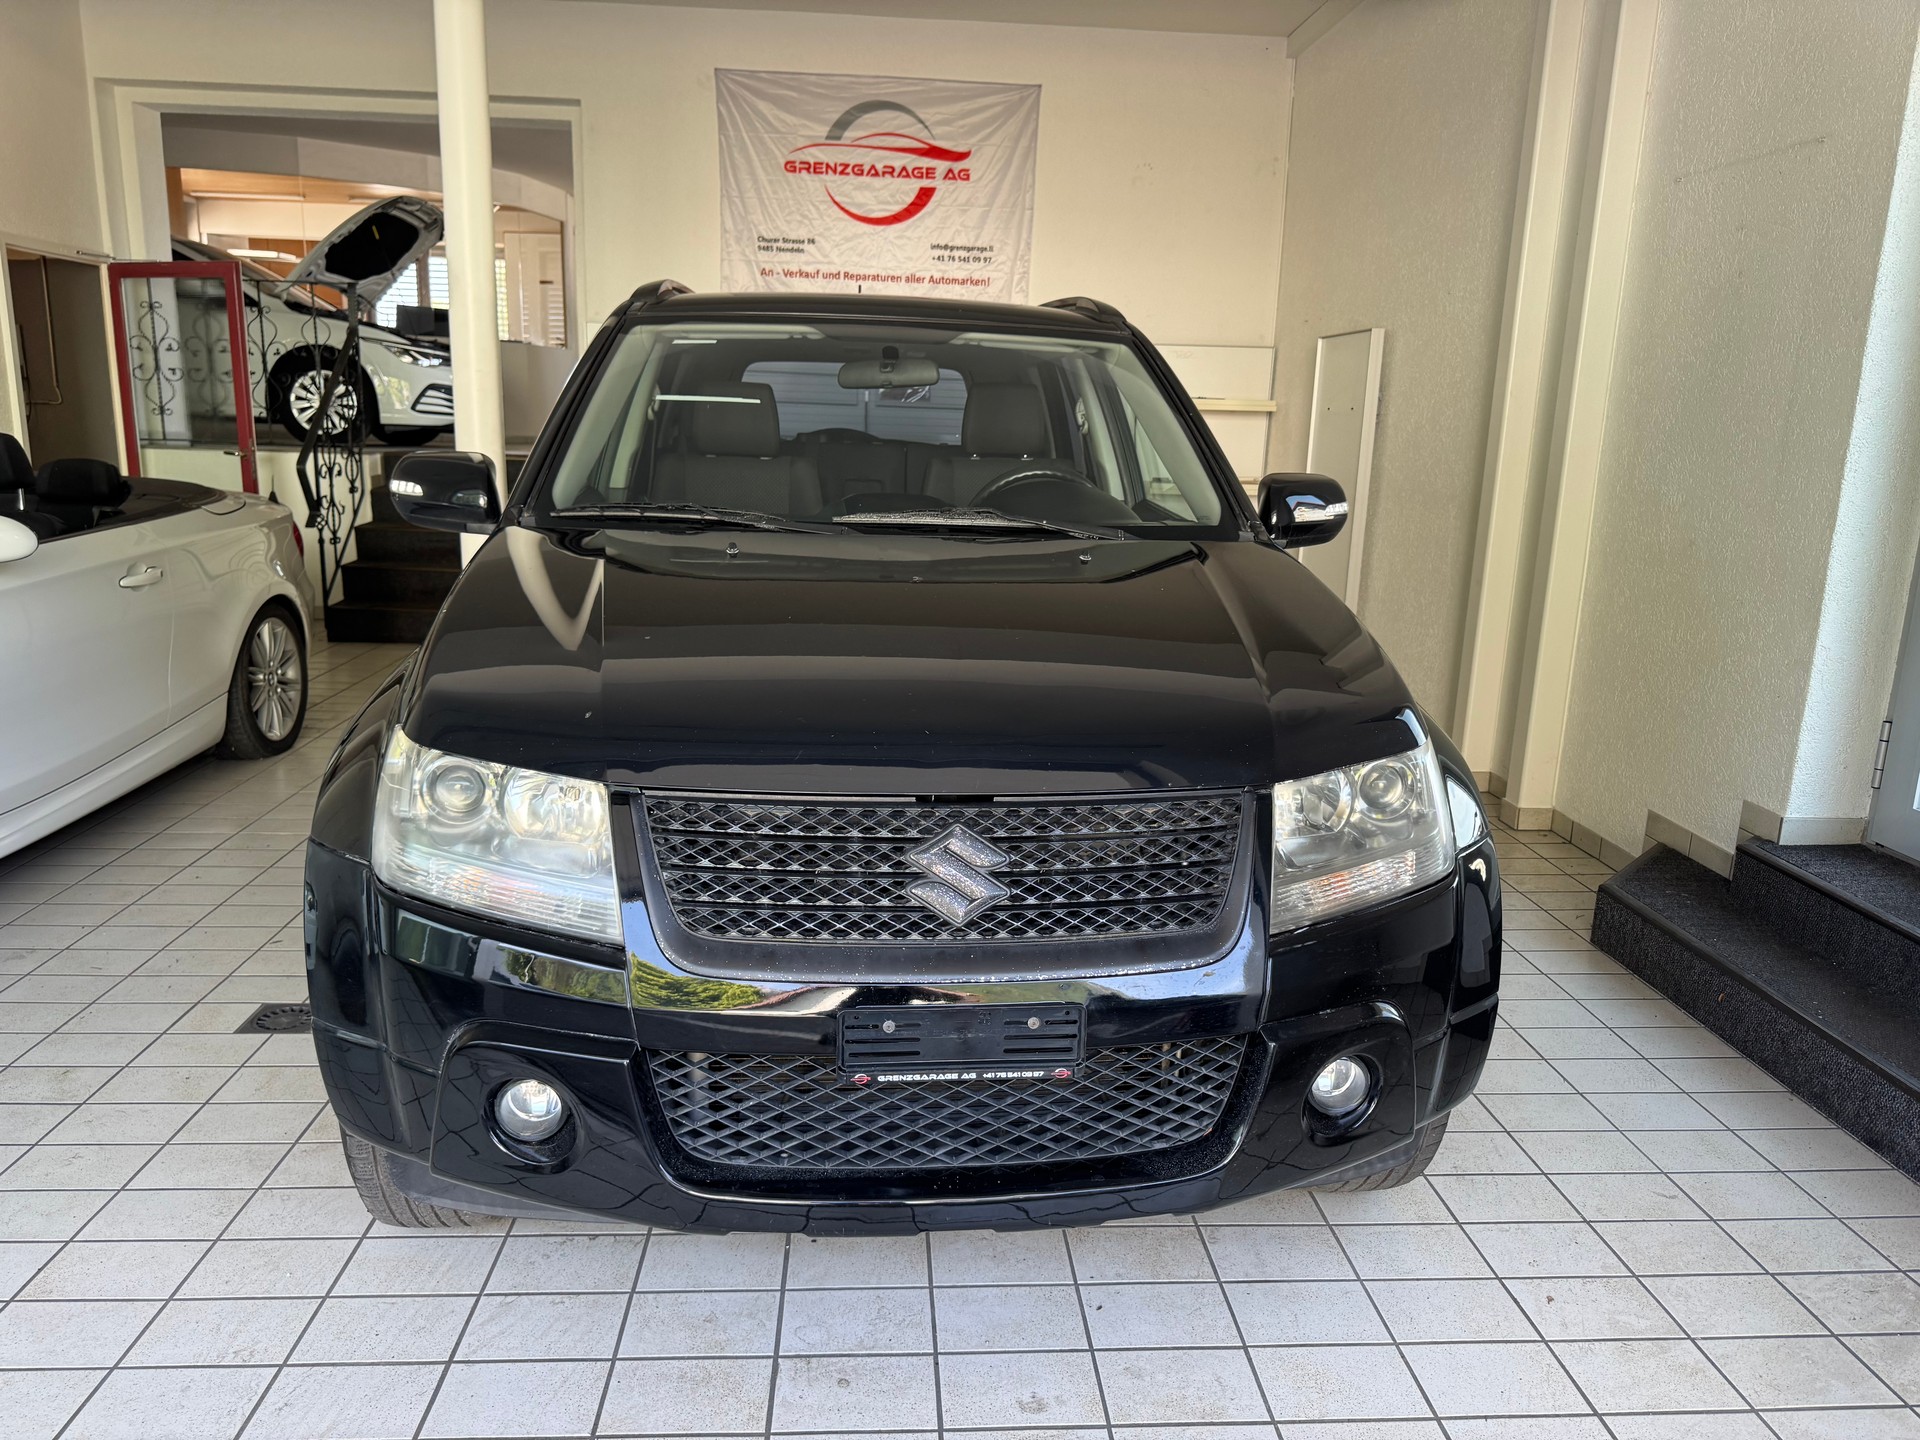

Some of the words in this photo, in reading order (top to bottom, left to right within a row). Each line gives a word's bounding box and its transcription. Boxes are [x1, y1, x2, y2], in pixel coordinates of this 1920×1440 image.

[784, 160, 937, 180] GRENZGARAGE
[942, 168, 971, 182] AG
[782, 236, 805, 246] Strasse
[947, 255, 956, 263] 76
[760, 268, 774, 277] An
[782, 268, 820, 279] Verkauf
[822, 271, 840, 280] und
[843, 271, 902, 283] Reparaturen
[904, 273, 926, 284] aller
[928, 275, 990, 287] Automarken!
[877, 1073, 959, 1082] GRENZGARAGE
[961, 1072, 977, 1080] AG
